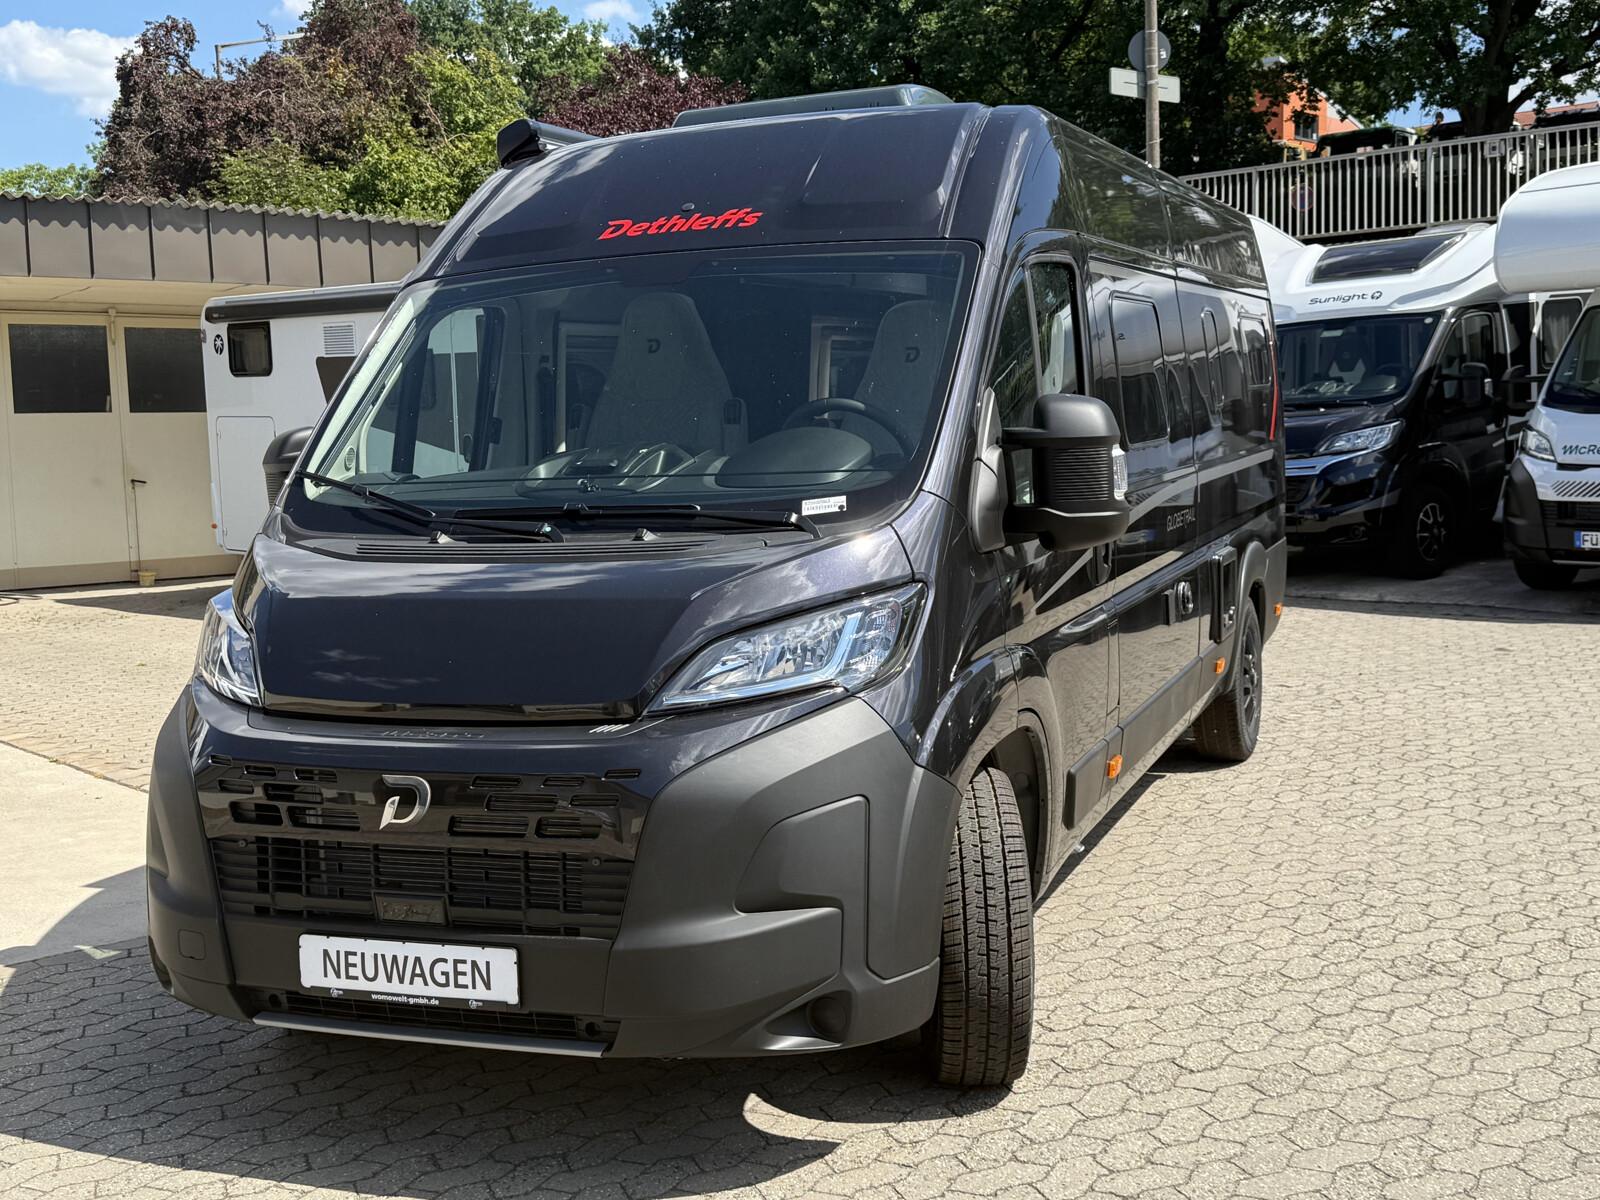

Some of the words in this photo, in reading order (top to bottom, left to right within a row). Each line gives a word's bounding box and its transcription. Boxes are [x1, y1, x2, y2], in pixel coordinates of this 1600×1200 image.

[597, 207, 764, 240] Dethleffs
[1308, 293, 1369, 305] Sunlight
[1582, 533, 1598, 546] FÜ
[322, 948, 492, 991] NEUWAGEN
[371, 993, 440, 1006] womowelt-gmbh.de
